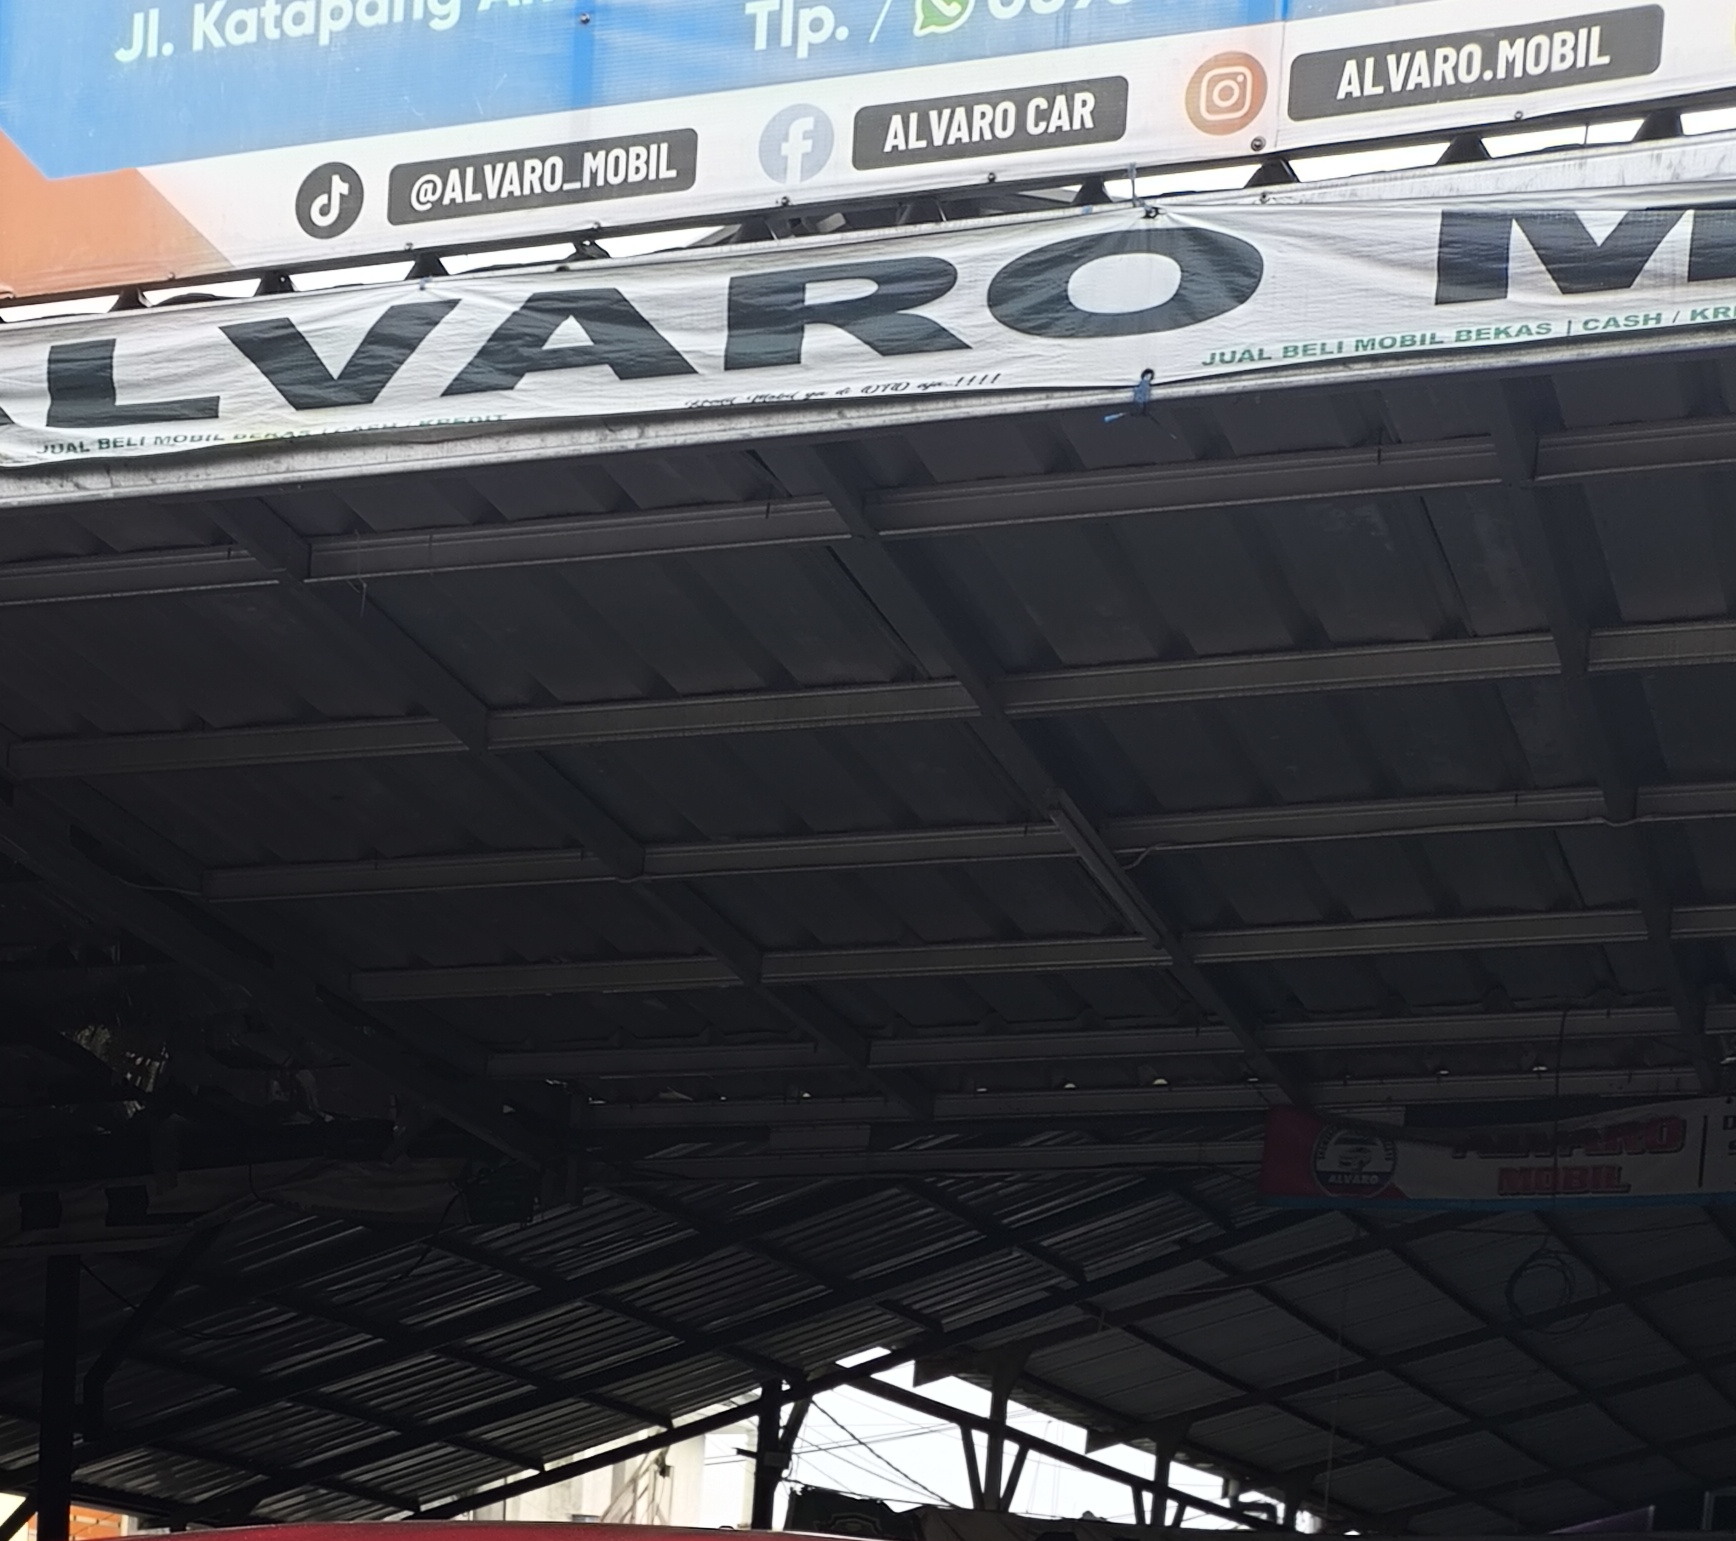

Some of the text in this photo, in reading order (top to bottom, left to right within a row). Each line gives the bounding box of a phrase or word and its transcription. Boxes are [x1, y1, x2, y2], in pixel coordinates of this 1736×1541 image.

[114, 0, 461, 62] Jl. Katapang
[745, 4, 849, 59] Tlp.
[1337, 26, 1611, 100] ALVARO.MOBIL
[884, 92, 1097, 153] ALVARO CAR
[410, 142, 678, 212] @ALVARO_MOBIL
[1202, 348, 1272, 366] JUAL
[1282, 341, 1344, 359] BELI
[1355, 330, 1446, 351] MOBIL
[1453, 322, 1552, 343] BEKAS
[1582, 312, 1662, 332] CASH
[35, 441, 91, 455] JUAL
[98, 436, 145, 450] BELI
[154, 434, 226, 446] MOBIL
[1328, 1173, 1379, 1185] ALVARO
[1496, 1164, 1630, 1195] MOBIL
